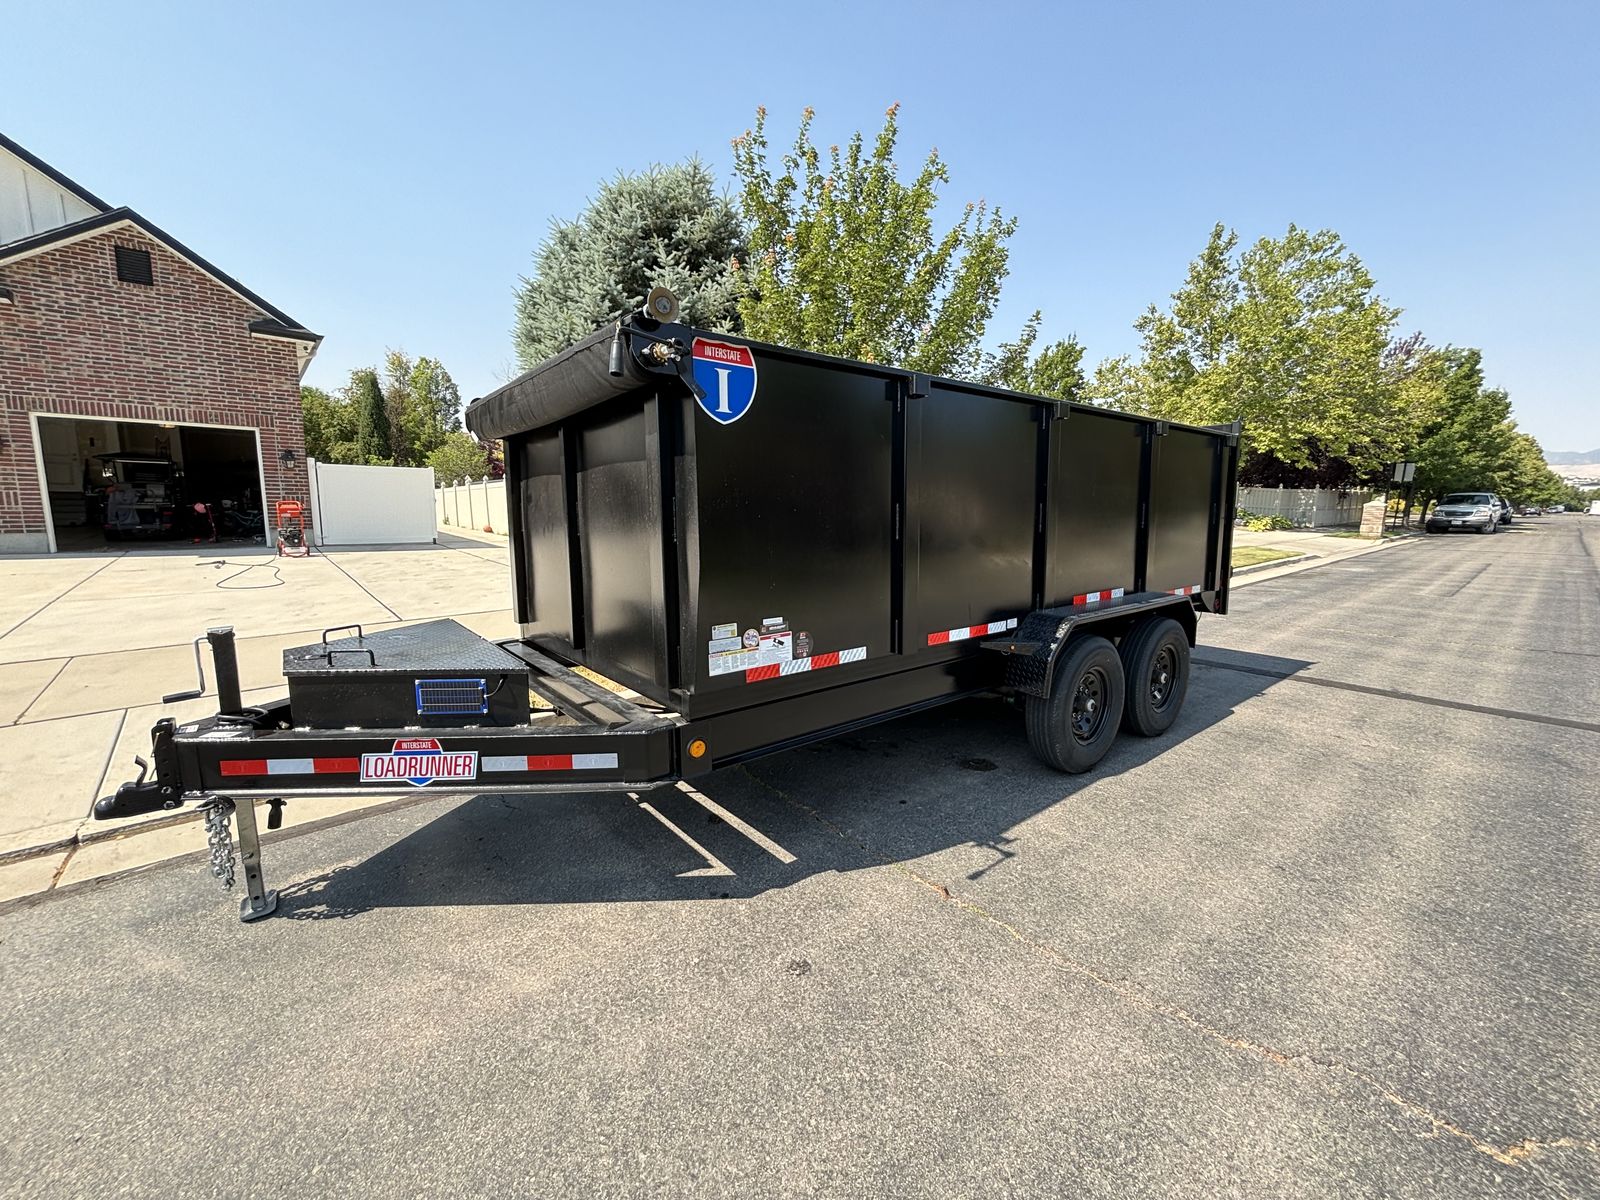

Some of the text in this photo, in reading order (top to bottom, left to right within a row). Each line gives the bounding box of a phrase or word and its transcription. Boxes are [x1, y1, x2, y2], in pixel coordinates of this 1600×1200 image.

[704, 345, 741, 361] INTERSTATE
[714, 368, 732, 413] I
[401, 741, 432, 750] INTERSTATE
[365, 756, 472, 777] LOADRUNNER
